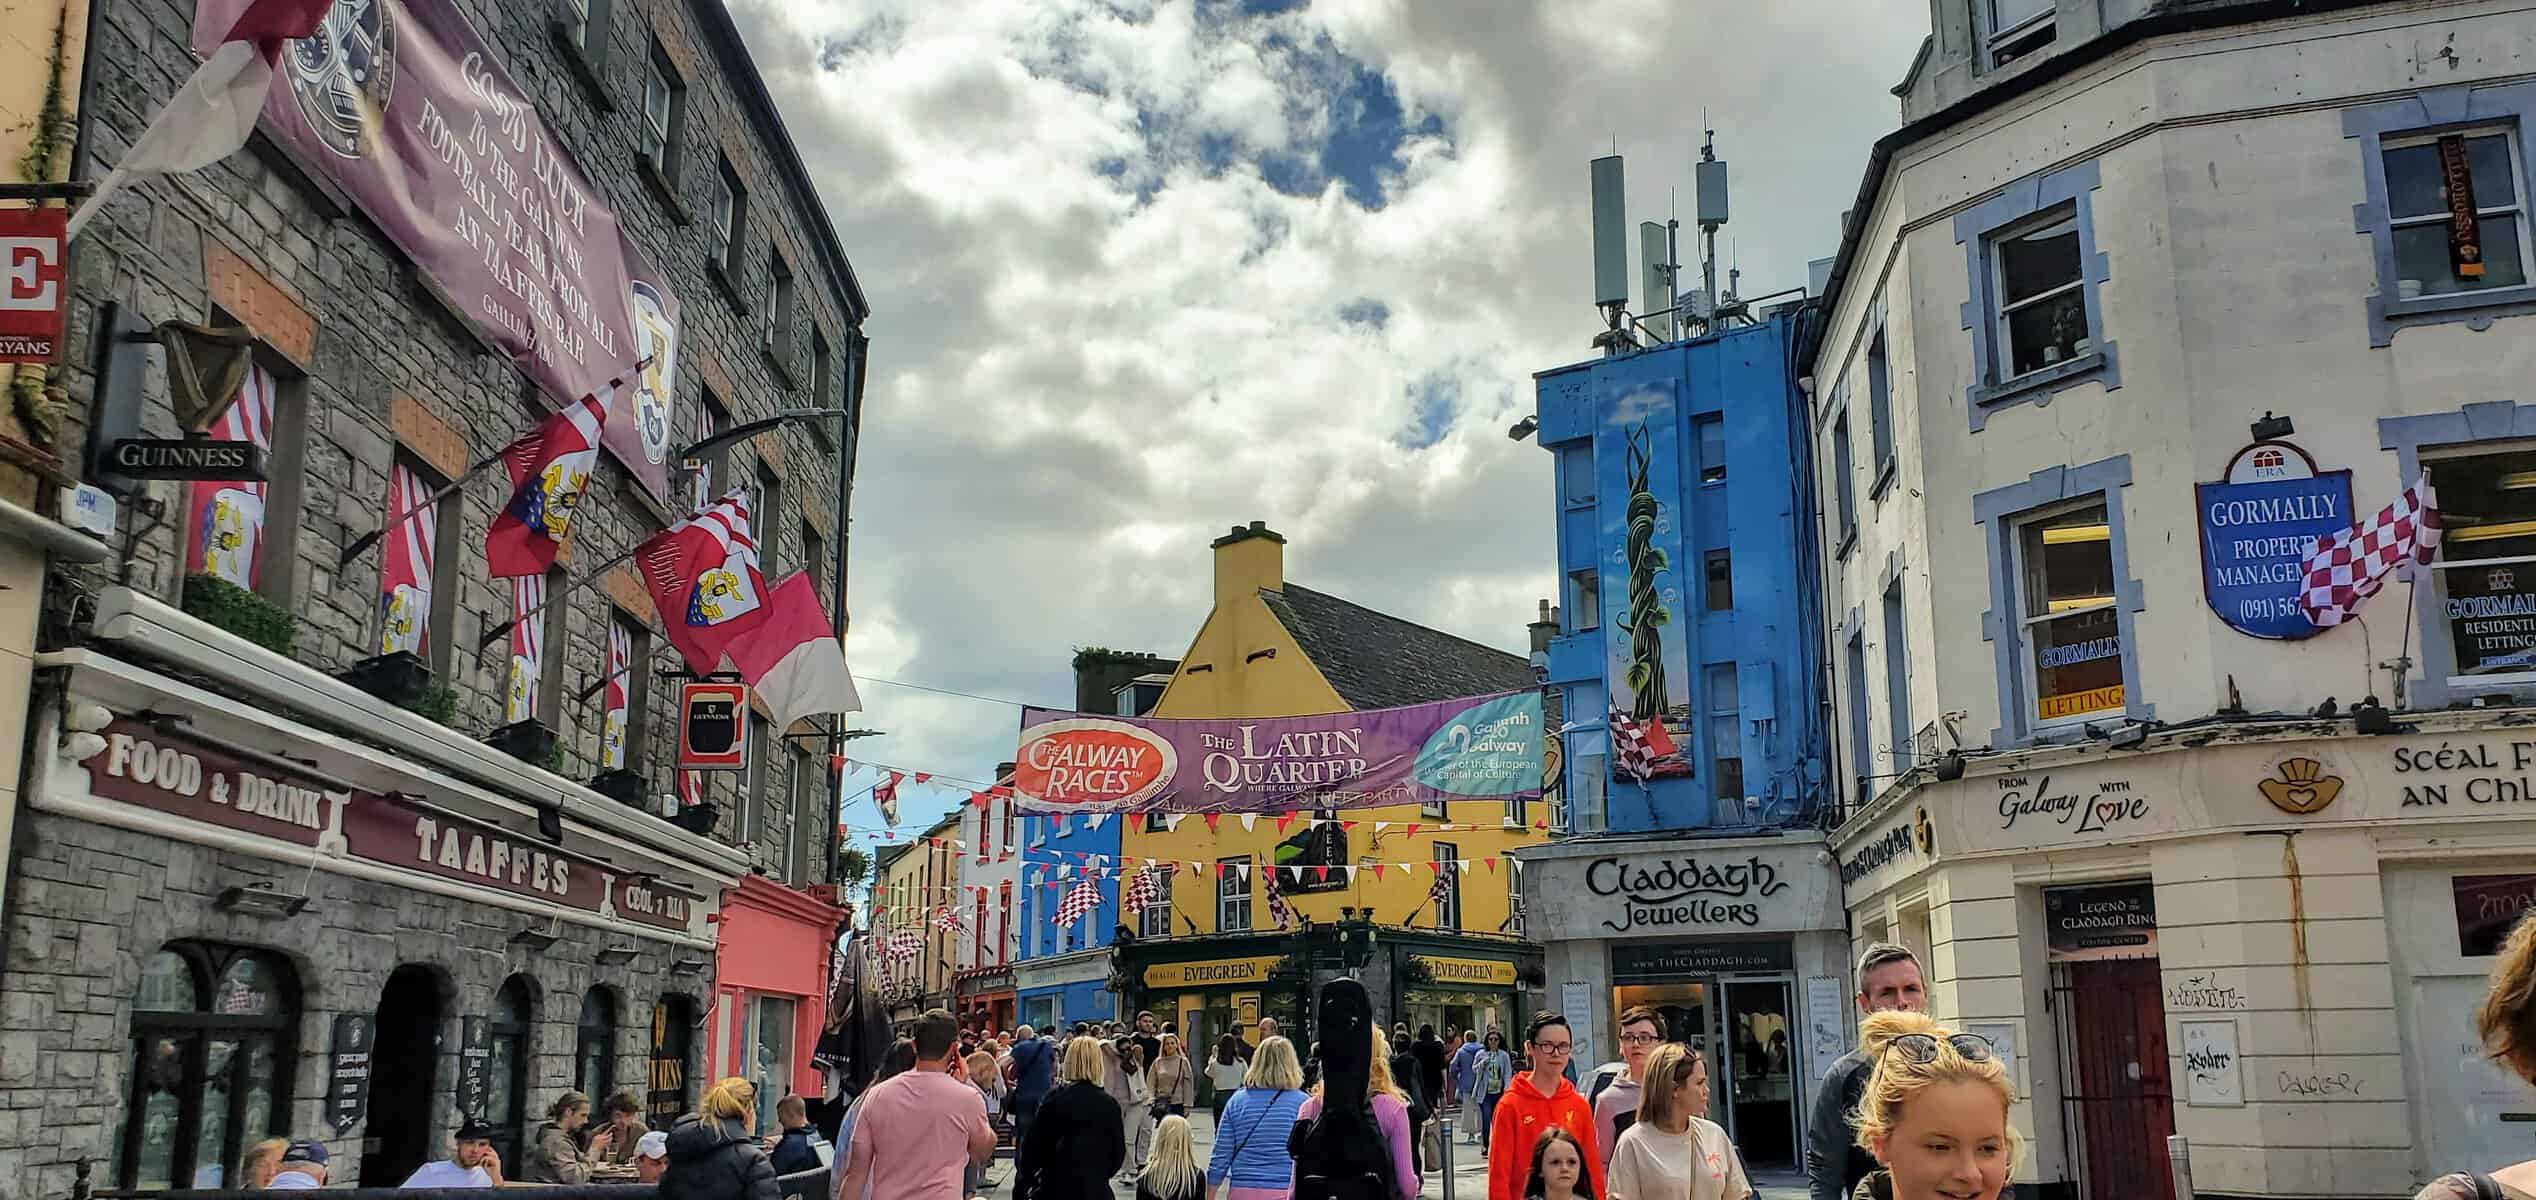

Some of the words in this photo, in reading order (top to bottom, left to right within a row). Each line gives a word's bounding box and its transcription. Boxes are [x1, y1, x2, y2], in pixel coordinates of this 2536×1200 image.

[461, 51, 527, 153] GOOD
[469, 108, 488, 156] TO
[489, 140, 520, 200] THE
[521, 186, 583, 280] GALWAY
[416, 96, 501, 227] FOOTBALL
[504, 209, 547, 281] TEAM
[550, 262, 589, 329] FROM
[591, 311, 618, 359] ALL
[454, 205, 480, 250] AT
[484, 232, 553, 330] TAAFFES
[554, 311, 585, 367] BAR
[482, 293, 537, 350] GAILLIMH
[118, 442, 246, 469] GUINNESS
[2255, 466, 2286, 479] ERA
[2210, 493, 2338, 528] GORMALLY
[2240, 597, 2275, 625] (091)
[1028, 738, 1147, 772] GALWAY
[1042, 743, 1060, 756] THE
[1200, 732, 1236, 751] THE
[1238, 725, 1363, 760] LATIN
[2394, 741, 2498, 773] SCÉAL
[2511, 742, 2536, 771] F
[1203, 752, 1368, 793] QUARTER
[1490, 756, 1538, 771] European
[107, 732, 202, 798] FOOD
[210, 771, 231, 805] &
[235, 771, 322, 830] DRINK
[1045, 766, 1133, 799] RACES
[1998, 776, 2028, 790] FROM
[2099, 780, 2131, 793] WITH
[2401, 784, 2449, 807] AN
[1998, 775, 2080, 830] Galway
[415, 815, 570, 897] TAAFFES
[625, 885, 654, 915] CEOL
[2079, 900, 2126, 914] LEGEND
[1184, 962, 1257, 982] EVERGREEN
[1434, 960, 1494, 979] EVERGREEN
